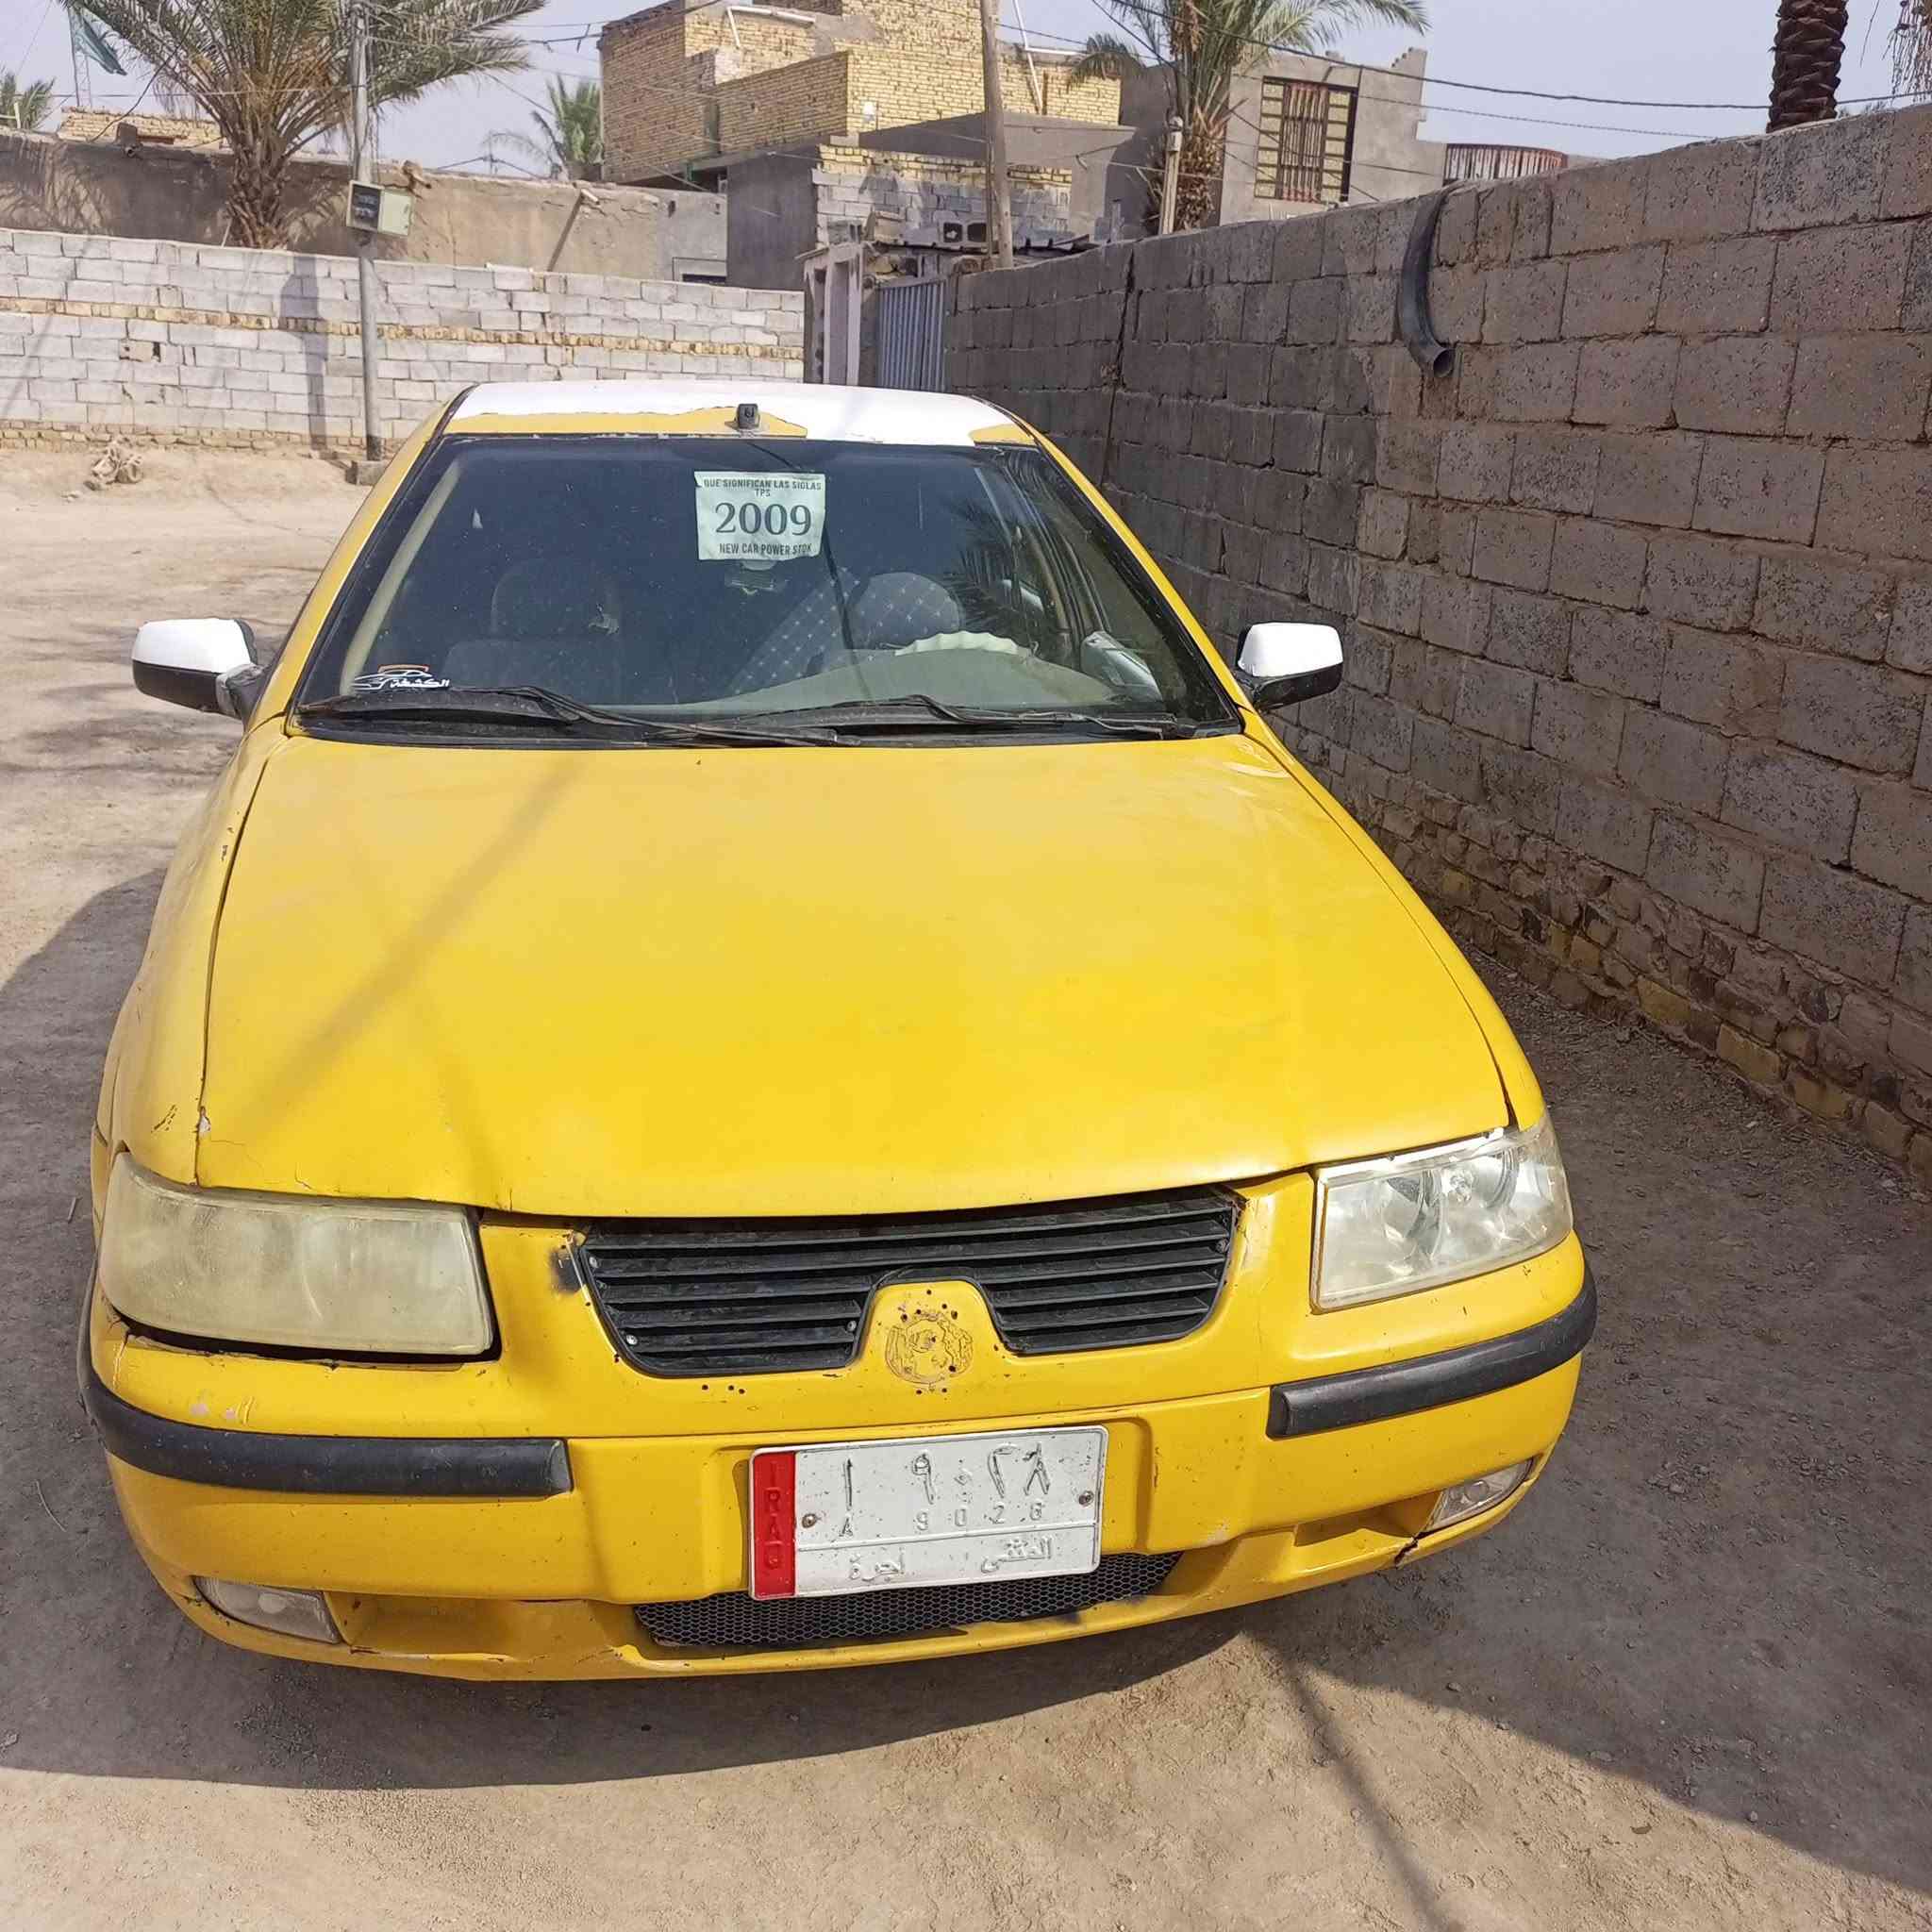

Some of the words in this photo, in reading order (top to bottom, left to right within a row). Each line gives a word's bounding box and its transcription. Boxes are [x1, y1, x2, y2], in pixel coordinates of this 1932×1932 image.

[723, 478, 772, 489] SIGNIFICAN
[774, 480, 790, 490] LAS
[715, 502, 812, 536] 2009
[719, 542, 739, 554] NEW
[741, 542, 760, 555] CAR
[760, 543, 791, 556] POWER
[765, 1460, 783, 1571] IRAQ
